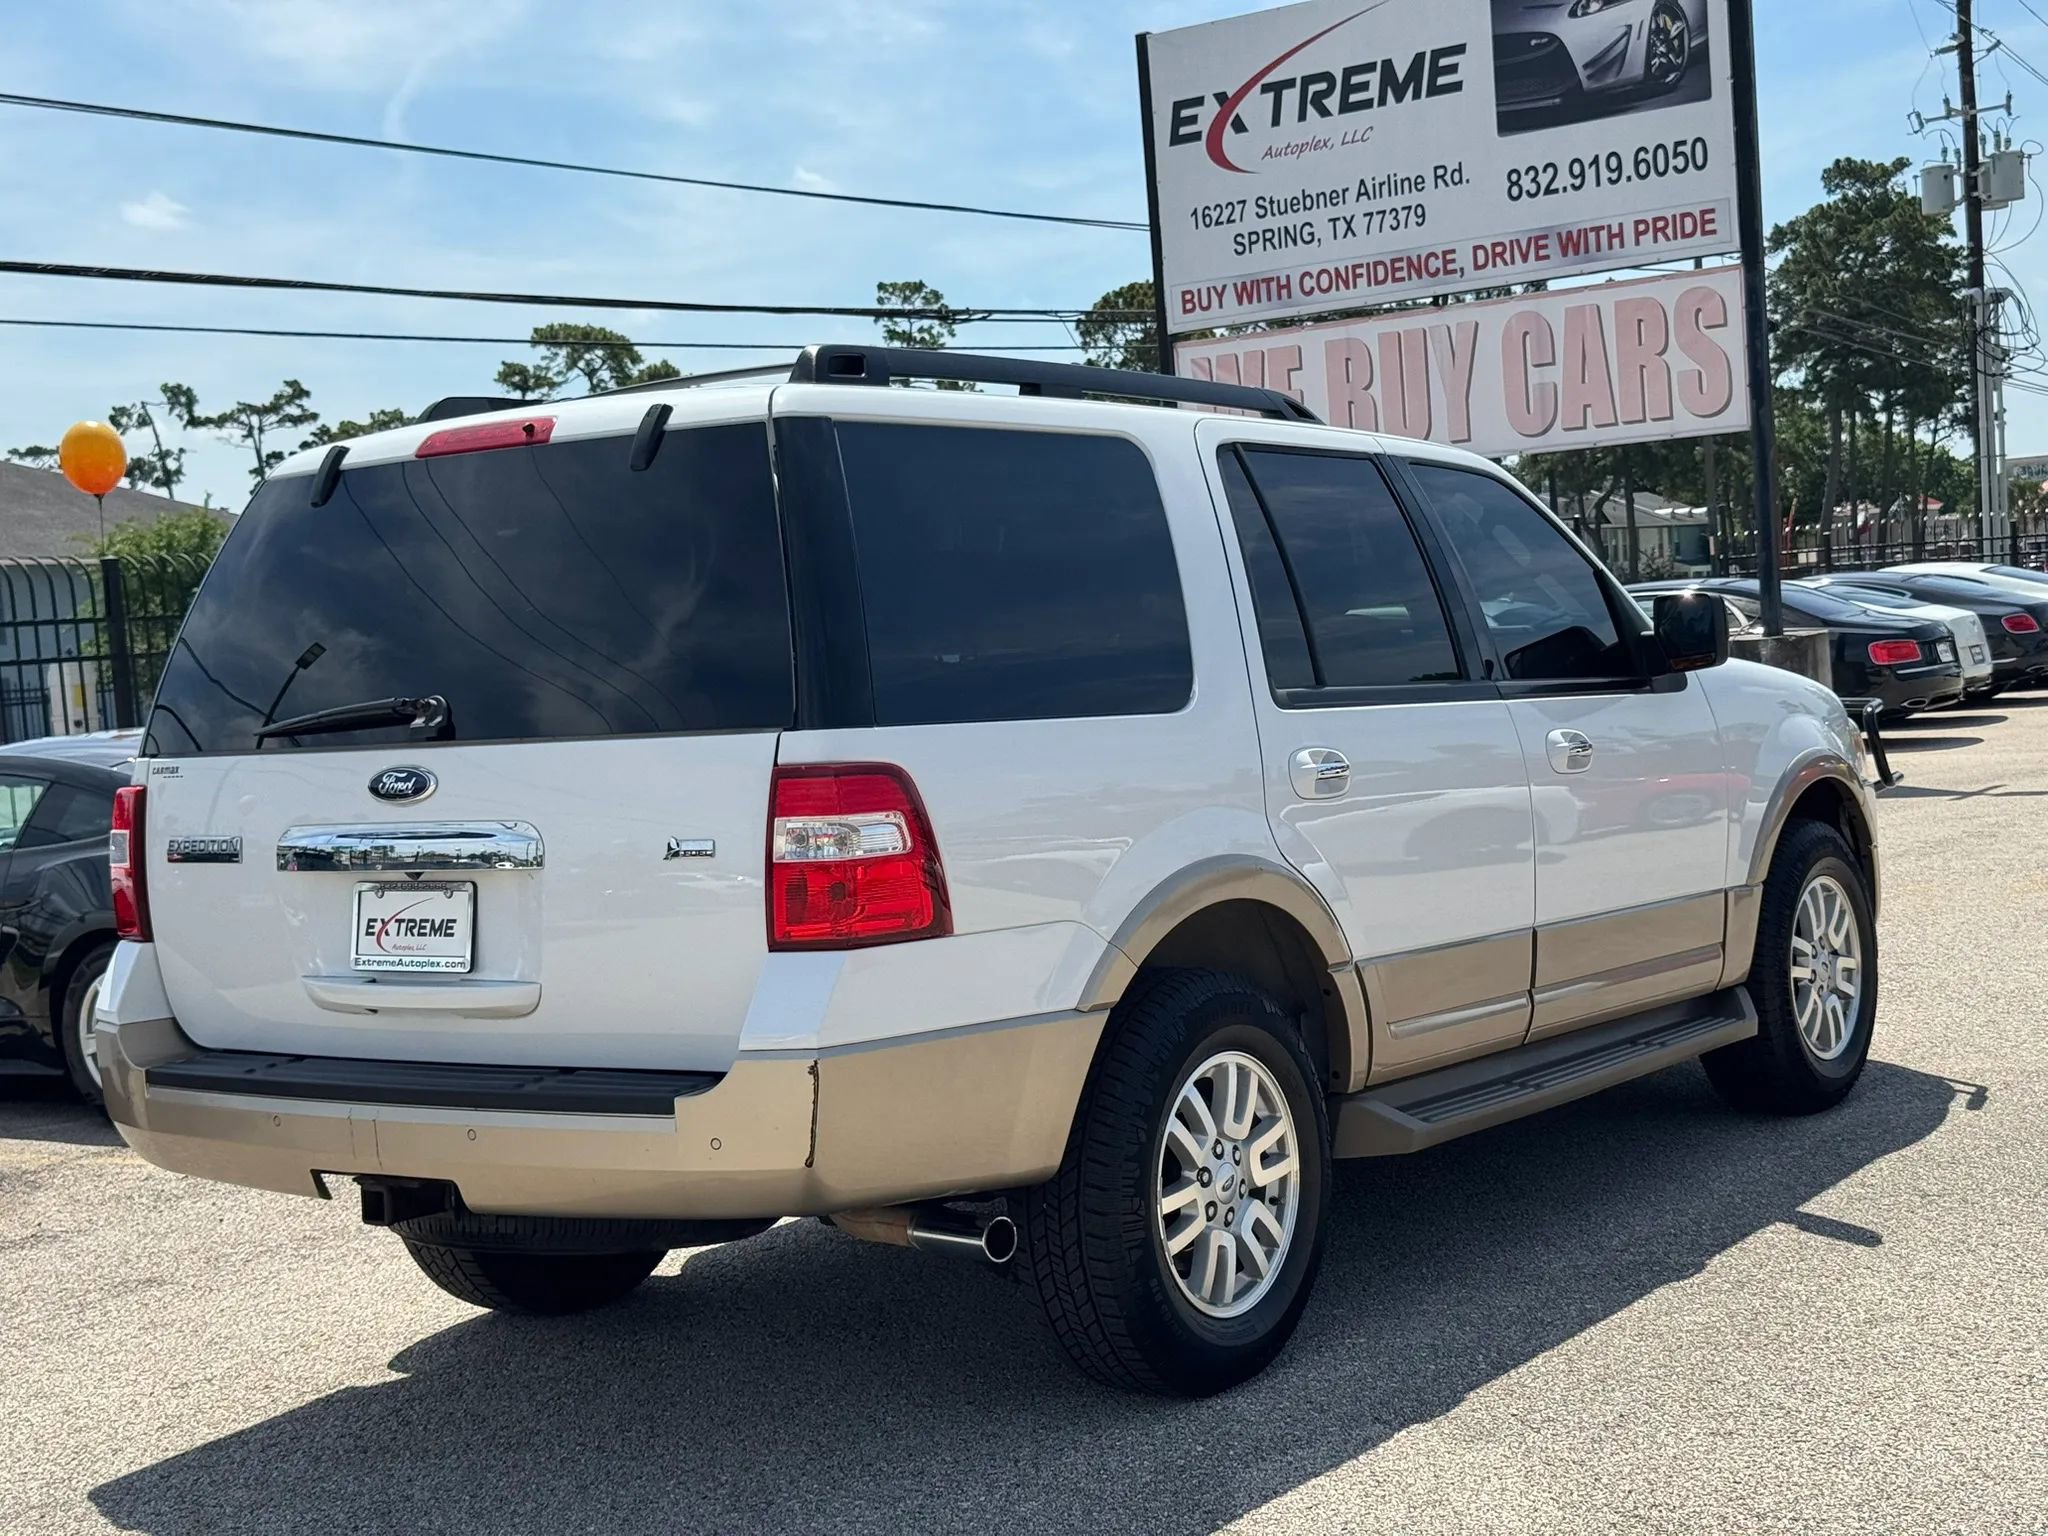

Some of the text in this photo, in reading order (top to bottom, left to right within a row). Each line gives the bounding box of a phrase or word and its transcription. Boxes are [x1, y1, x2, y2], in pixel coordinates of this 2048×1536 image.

[1169, 42, 1468, 147] EXTREME
[1261, 126, 1374, 161] Autoplex, LLC
[1505, 136, 1709, 202] 832.919.6050
[1189, 161, 1471, 231] 16227 Stuebner Airline Rd.
[1232, 204, 1426, 257] SPRING, TX 77379
[1181, 208, 1717, 316] BUY WITH CONFIDENCE, DRIVE WITH PRIDE
[1323, 320, 1478, 442] BUY
[1501, 286, 1734, 438] CARS
[378, 772, 417, 794] Ford
[168, 840, 240, 853] EXPEDITION
[365, 918, 457, 937] EXTREME
[354, 957, 466, 969] ExtremeAutoplex.com
